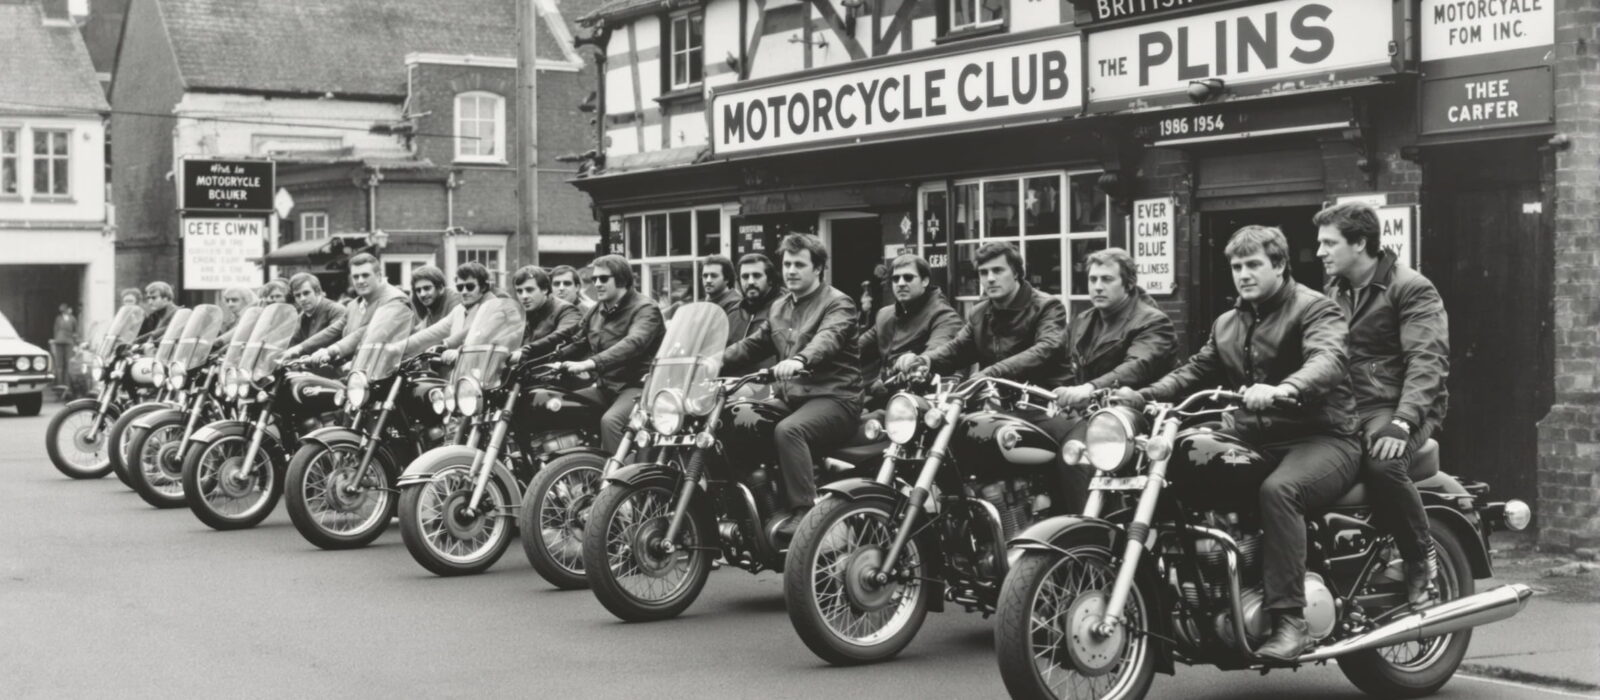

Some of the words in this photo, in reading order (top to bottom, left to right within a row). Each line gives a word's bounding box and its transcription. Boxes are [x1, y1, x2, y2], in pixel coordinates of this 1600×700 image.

[1097, 0, 1192, 19] BRIT
[1098, 56, 1128, 77] THE
[1138, 3, 1335, 87] PLINS
[1449, 24, 1482, 45] FOM
[723, 68, 947, 145] MOTORCYCLE
[957, 50, 1070, 112] CLUB
[1465, 79, 1510, 100] THEE
[1448, 100, 1519, 123] CARFER
[1160, 117, 1189, 136] 1986
[1193, 114, 1225, 132] 1954
[1137, 203, 1166, 219] EVER
[188, 222, 220, 236] CETE
[1138, 222, 1169, 237] CLMB
[1138, 241, 1167, 257] BLUE
